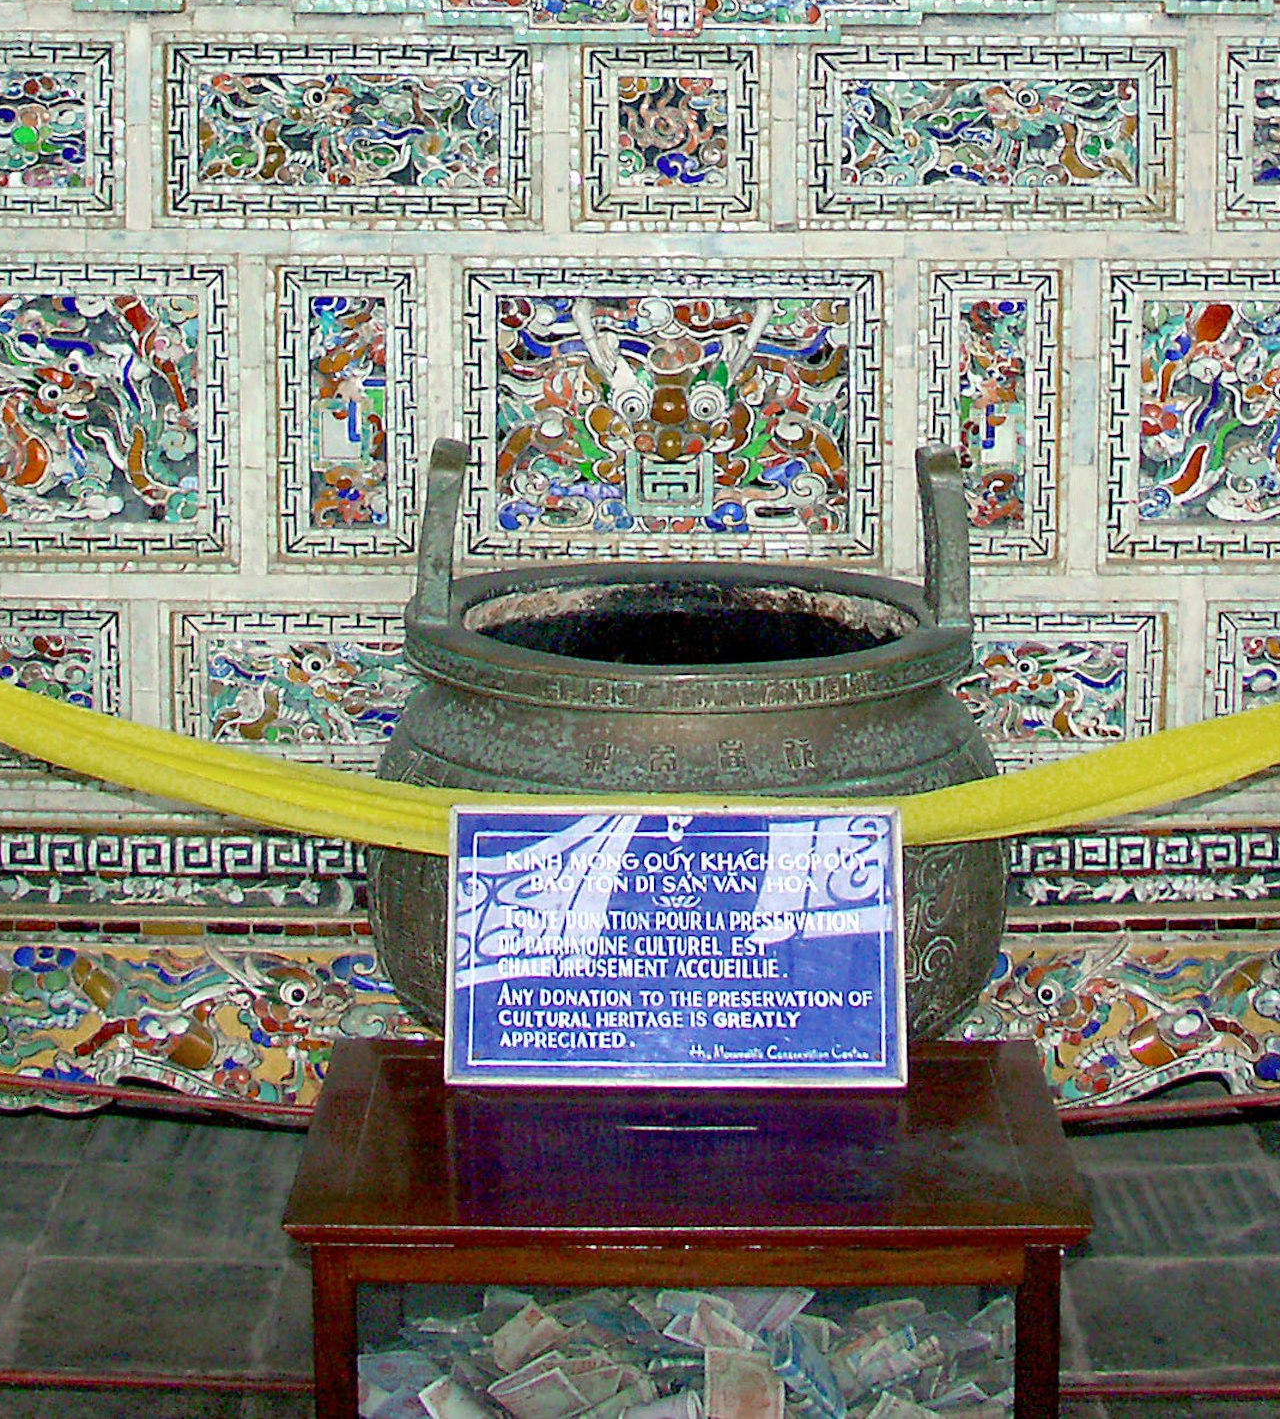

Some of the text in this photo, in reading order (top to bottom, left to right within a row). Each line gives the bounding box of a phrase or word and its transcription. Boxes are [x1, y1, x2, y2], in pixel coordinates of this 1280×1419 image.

[701, 848, 775, 871] KHÁCH
[566, 910, 650, 930] DONATION
[655, 910, 703, 931] POUR
[705, 910, 725, 931] LA
[729, 910, 860, 932] PRESERVATION
[498, 935, 769, 957] DU PATRIMOINE CULTUREL EST
[496, 957, 788, 979] CHALEUREUSEMENT ACCUEILLIE.
[539, 989, 632, 1007] DONATION
[639, 990, 664, 1007] TO
[669, 990, 702, 1007] THE
[707, 990, 843, 1008] PRESERVATION
[848, 990, 873, 1007] OF
[497, 1010, 801, 1029] CULTURAL HERITAGE IS GREATLY
[499, 1031, 636, 1049] APPRECIATED.
